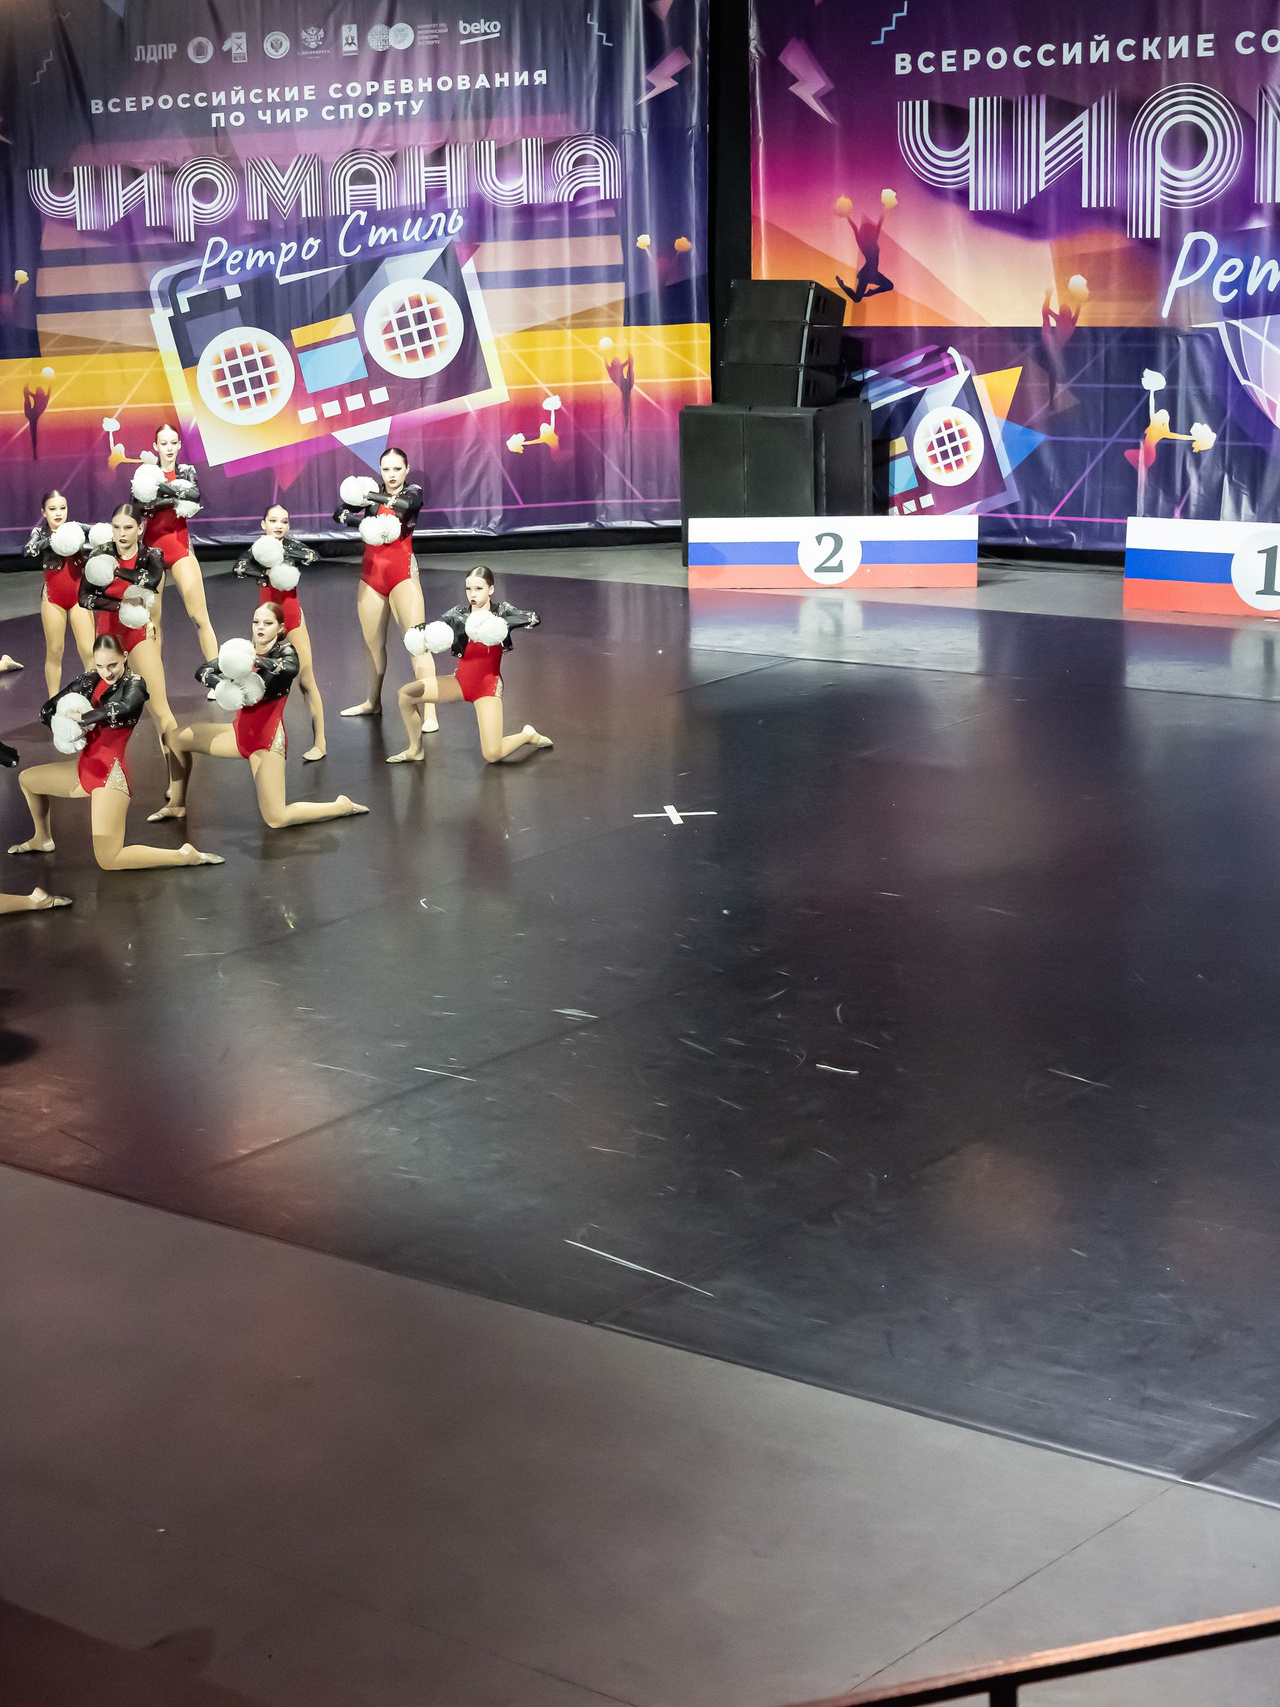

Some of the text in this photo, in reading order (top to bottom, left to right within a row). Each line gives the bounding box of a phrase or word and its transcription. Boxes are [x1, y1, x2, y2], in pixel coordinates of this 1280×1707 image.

[459, 19, 501, 35] beko
[134, 43, 177, 64] ЛДПР
[895, 33, 1215, 75] ВСЕРОССИЙСКИЕ
[91, 69, 547, 114] ВСЕРОССИЙСКИЕ СОРЕВНОВАНИЯ
[211, 100, 425, 128] ПО ЧИР СПОРТУ
[197, 208, 464, 286] Ретро Стиль
[813, 532, 844, 573] 2
[1255, 545, 1280, 596] 1
